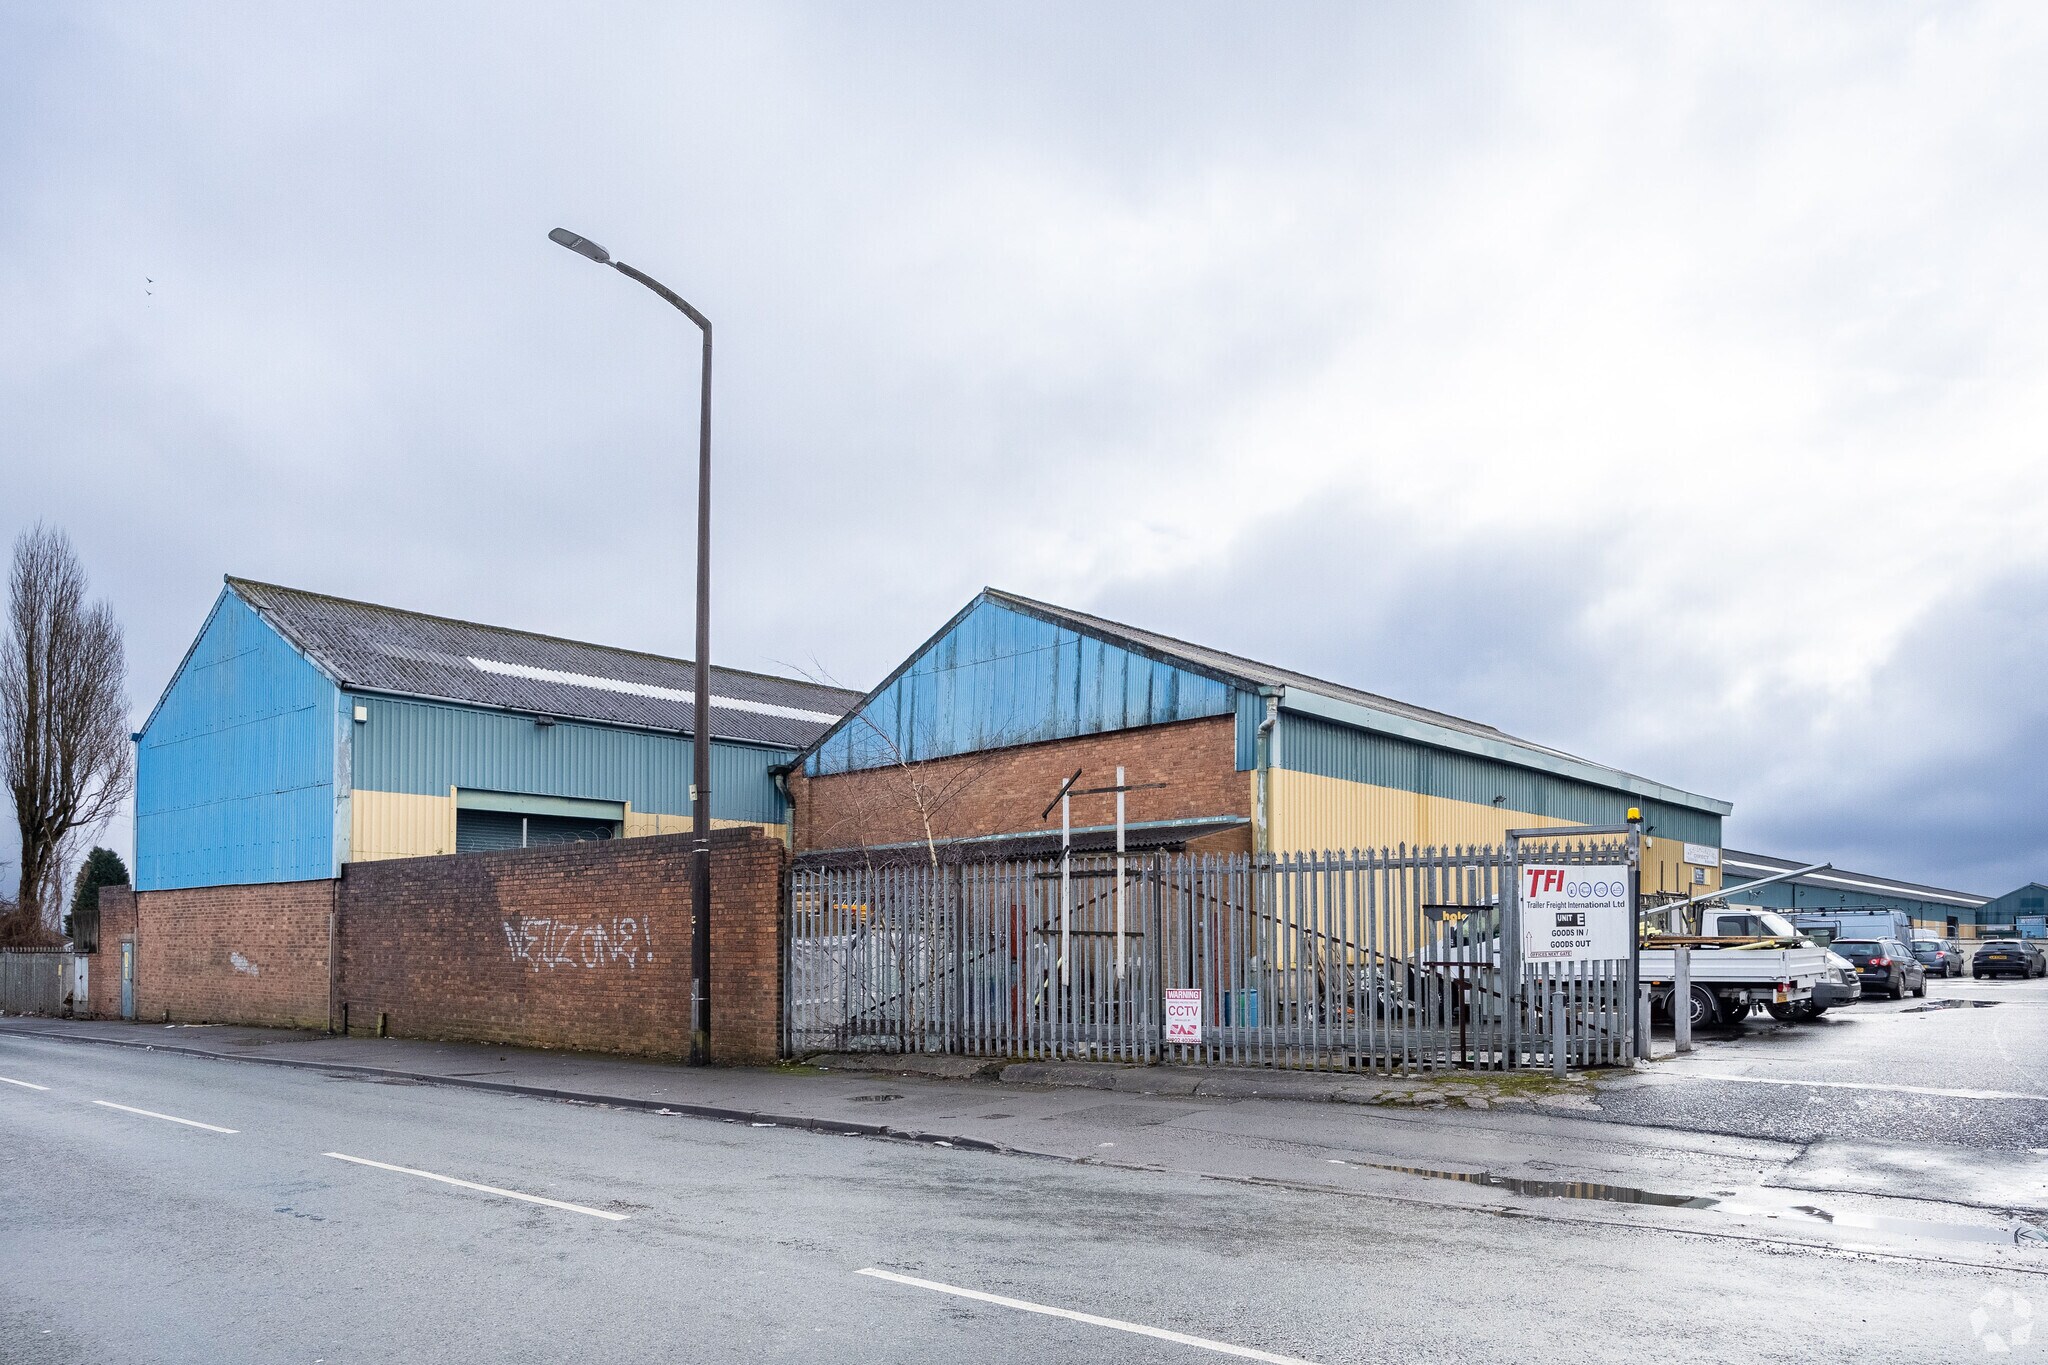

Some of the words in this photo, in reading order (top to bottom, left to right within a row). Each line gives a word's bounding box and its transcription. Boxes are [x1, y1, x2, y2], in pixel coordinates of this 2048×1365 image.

[1527, 869, 1565, 898] TFI
[1527, 901, 1545, 909] Trailer
[1546, 901, 1567, 910] Freight
[1568, 900, 1611, 909] International
[1613, 900, 1625, 908] Ltd
[1557, 914, 1573, 922] UNIT
[1577, 914, 1585, 926] E
[1551, 929, 1575, 937] GOODS
[1550, 940, 1574, 948] GOODS
[1575, 940, 1592, 948] OUT
[1168, 990, 1199, 999] WARNING
[1168, 1005, 1199, 1017] CCTV
